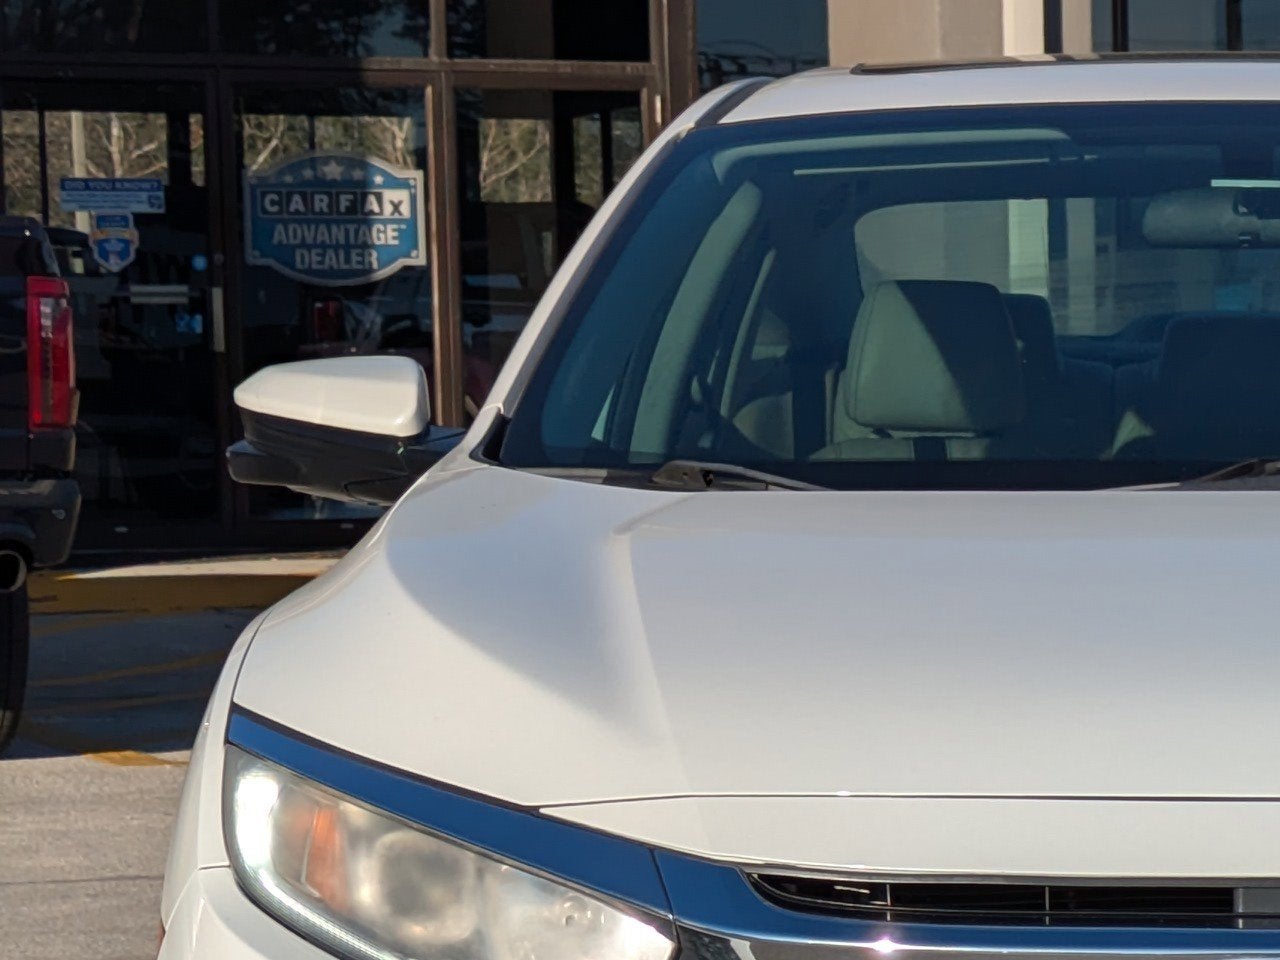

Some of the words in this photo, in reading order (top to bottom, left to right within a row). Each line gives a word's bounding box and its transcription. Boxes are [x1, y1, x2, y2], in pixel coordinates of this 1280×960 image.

[264, 193, 404, 216] CARFAX
[272, 223, 400, 245] ADVANTAGE
[295, 249, 378, 270] DEALER
